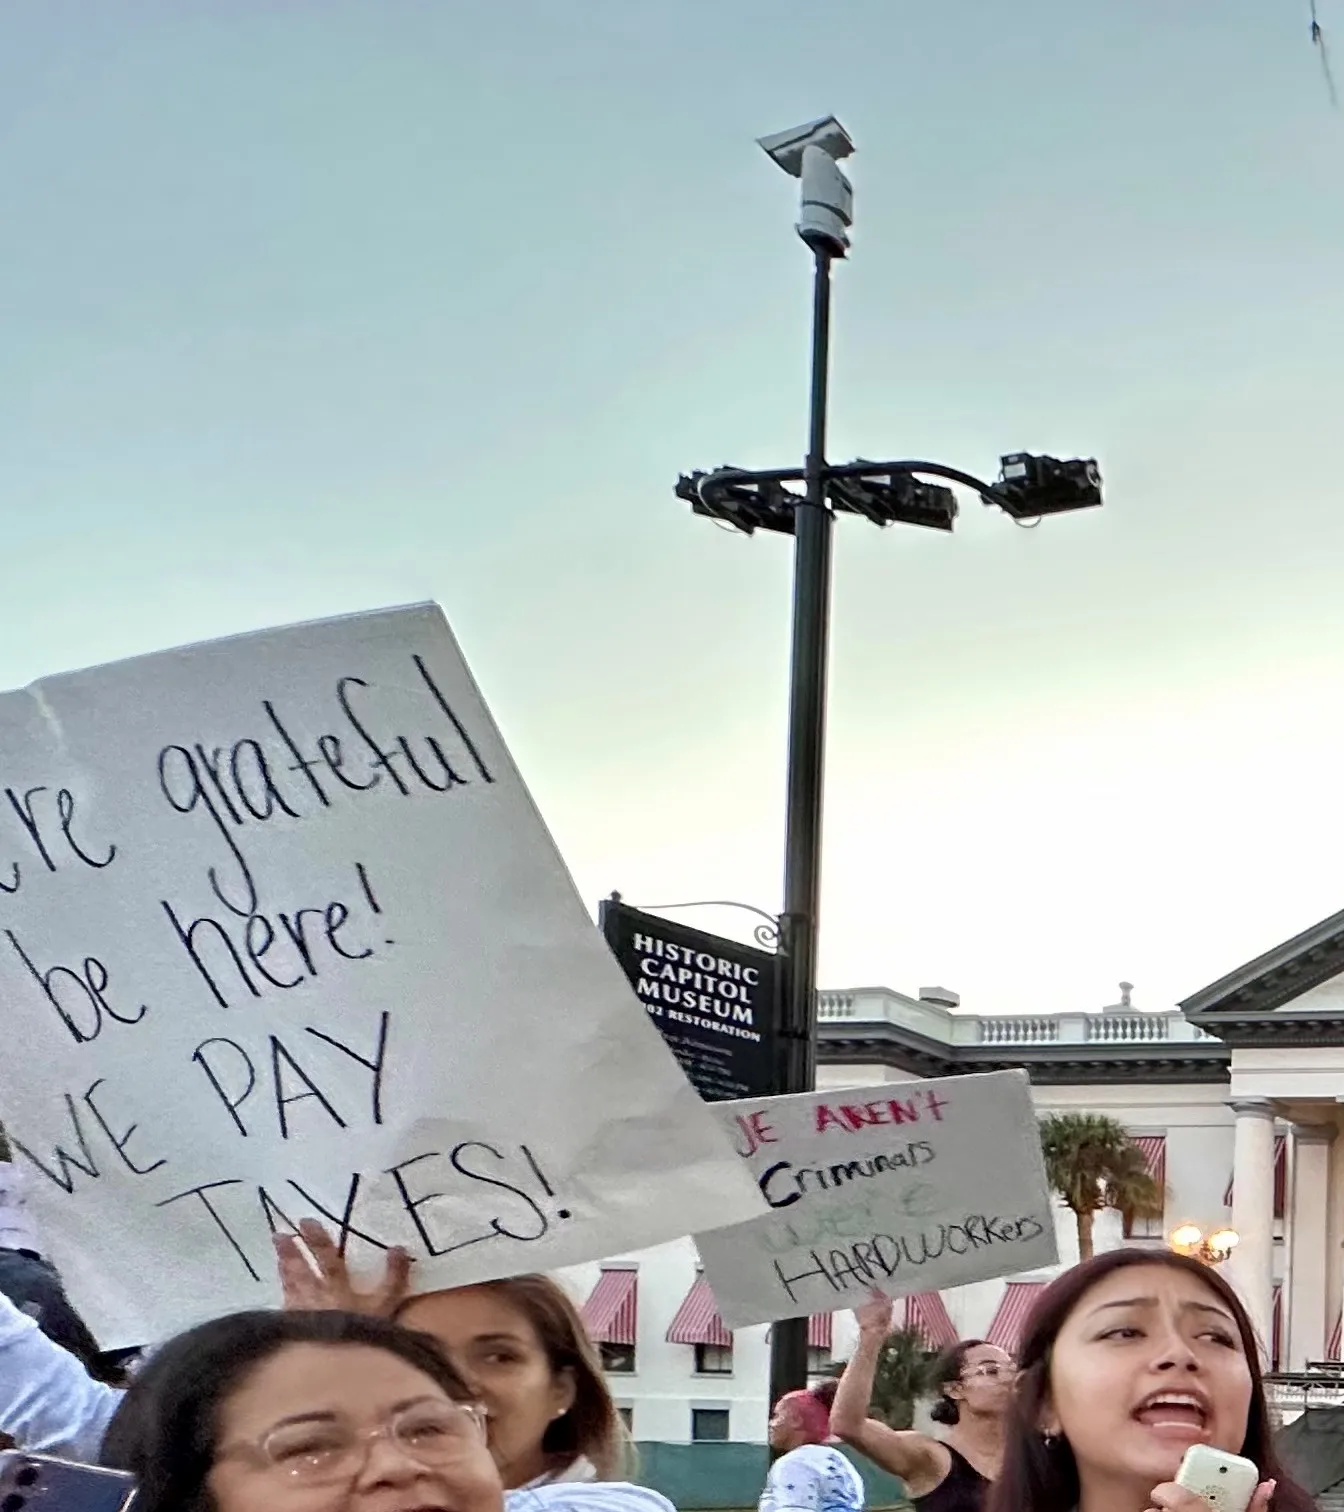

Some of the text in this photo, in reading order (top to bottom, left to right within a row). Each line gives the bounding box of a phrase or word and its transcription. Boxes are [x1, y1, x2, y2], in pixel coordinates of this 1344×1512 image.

[0, 654, 497, 912] re grateful
[4, 862, 395, 1044] be here!
[632, 932, 760, 986] HISTORIC
[637, 977, 754, 1026] MUSEUM
[640, 958, 752, 1004] CAPITOL
[643, 1003, 761, 1043] 02 RESTORATION
[9, 1011, 390, 1194] WE PAY
[154, 1141, 572, 1281] TAXES!
